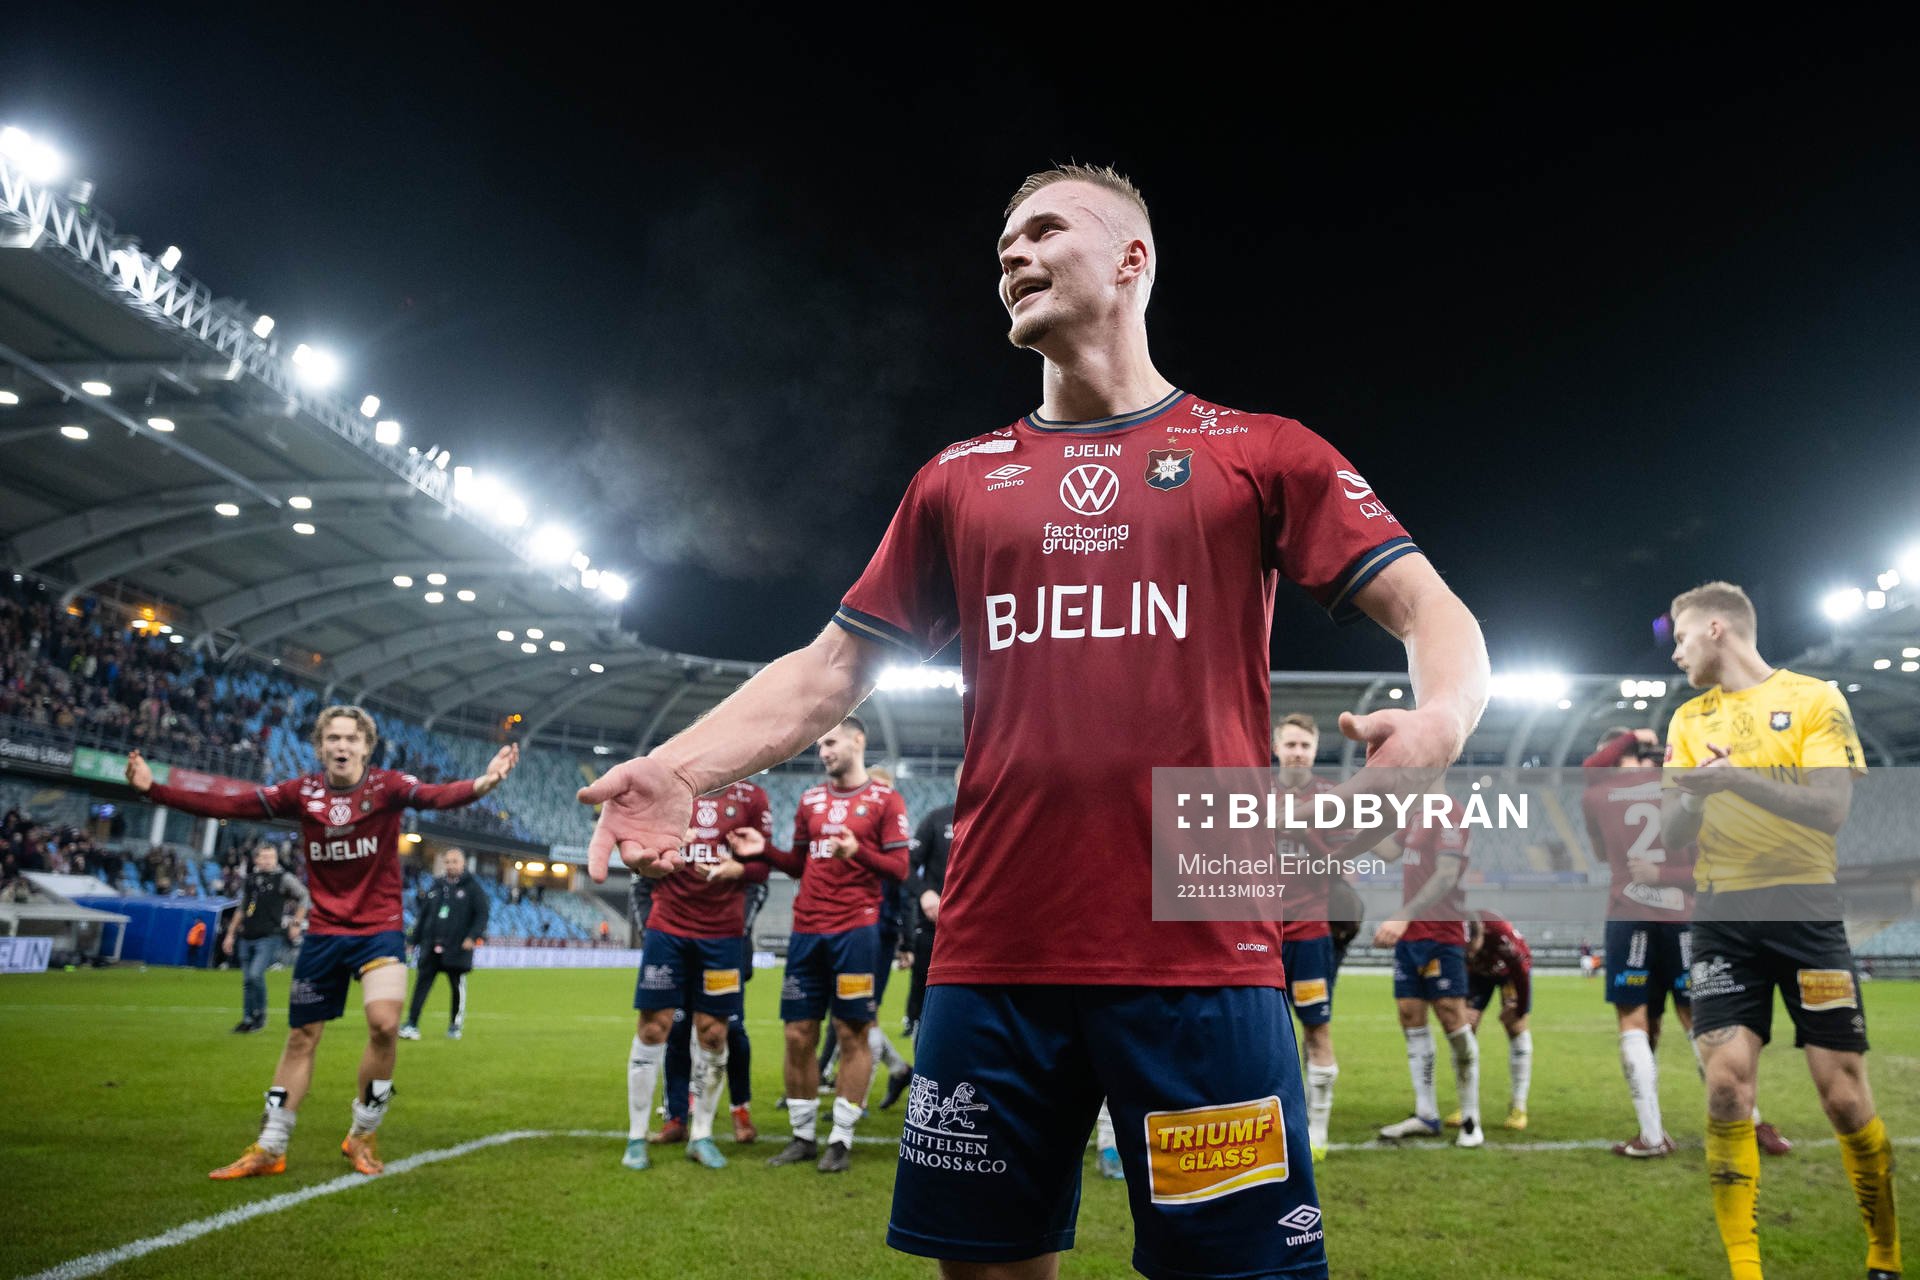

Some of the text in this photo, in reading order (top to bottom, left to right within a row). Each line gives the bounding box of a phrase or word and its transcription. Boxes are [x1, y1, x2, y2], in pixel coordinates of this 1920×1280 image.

[1166, 425, 1249, 436] ERNST ROSÉN
[1063, 444, 1122, 458] BJELIN
[987, 479, 1025, 491] umbro
[1043, 522, 1129, 541] factoring
[985, 580, 1188, 651] BJELIN
[309, 836, 378, 861] BJELIN
[1236, 942, 1269, 953] QUICKDRY
[1157, 1114, 1274, 1152] TRIUMF
[899, 1142, 1008, 1174] UNROSS&CO
[1179, 1146, 1257, 1172] GLASS
[1286, 1229, 1323, 1247] umbro
